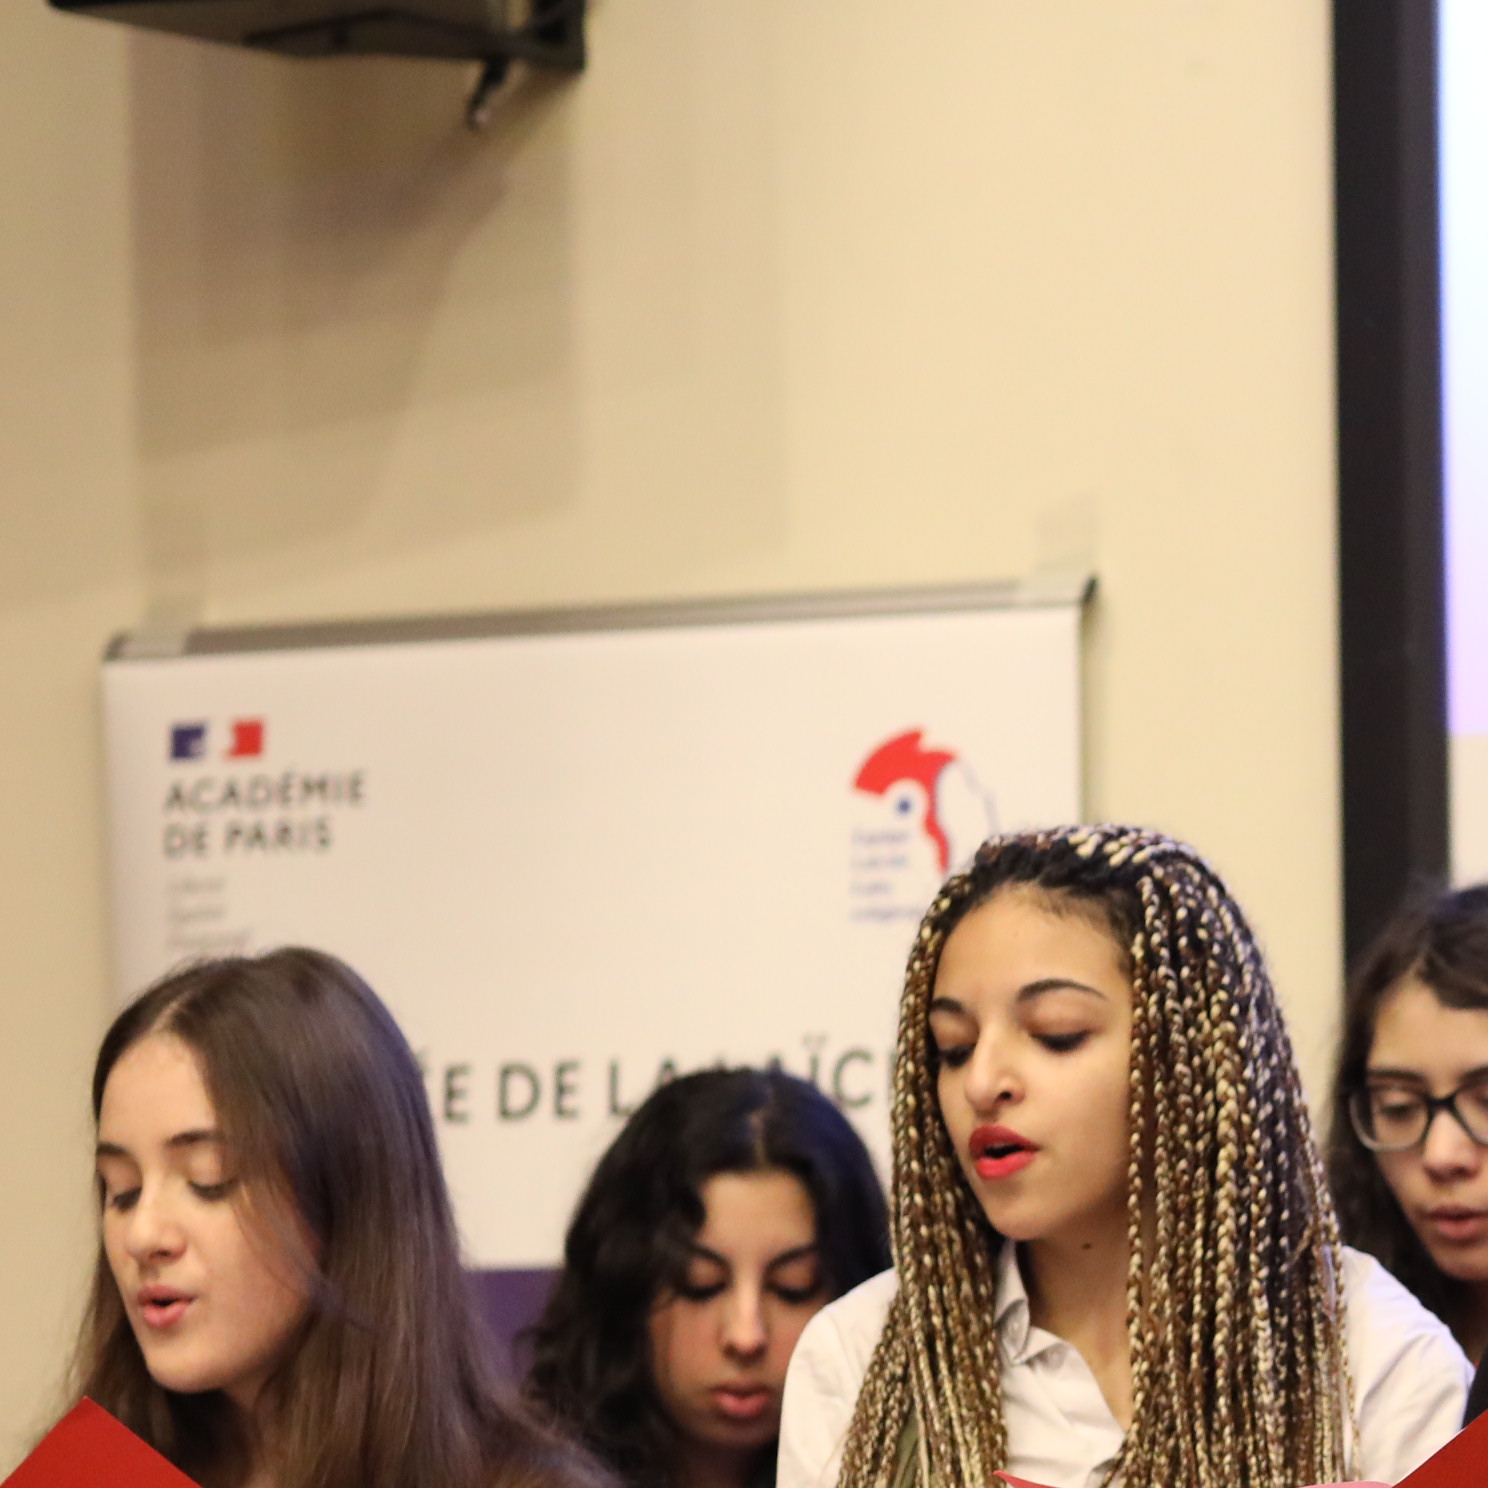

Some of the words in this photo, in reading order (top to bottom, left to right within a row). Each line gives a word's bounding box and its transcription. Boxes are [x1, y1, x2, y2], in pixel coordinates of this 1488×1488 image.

[164, 768, 364, 812] ACADÉMIE
[164, 822, 208, 858] DE
[225, 816, 331, 853] PARIS
[497, 1061, 583, 1121] DE
